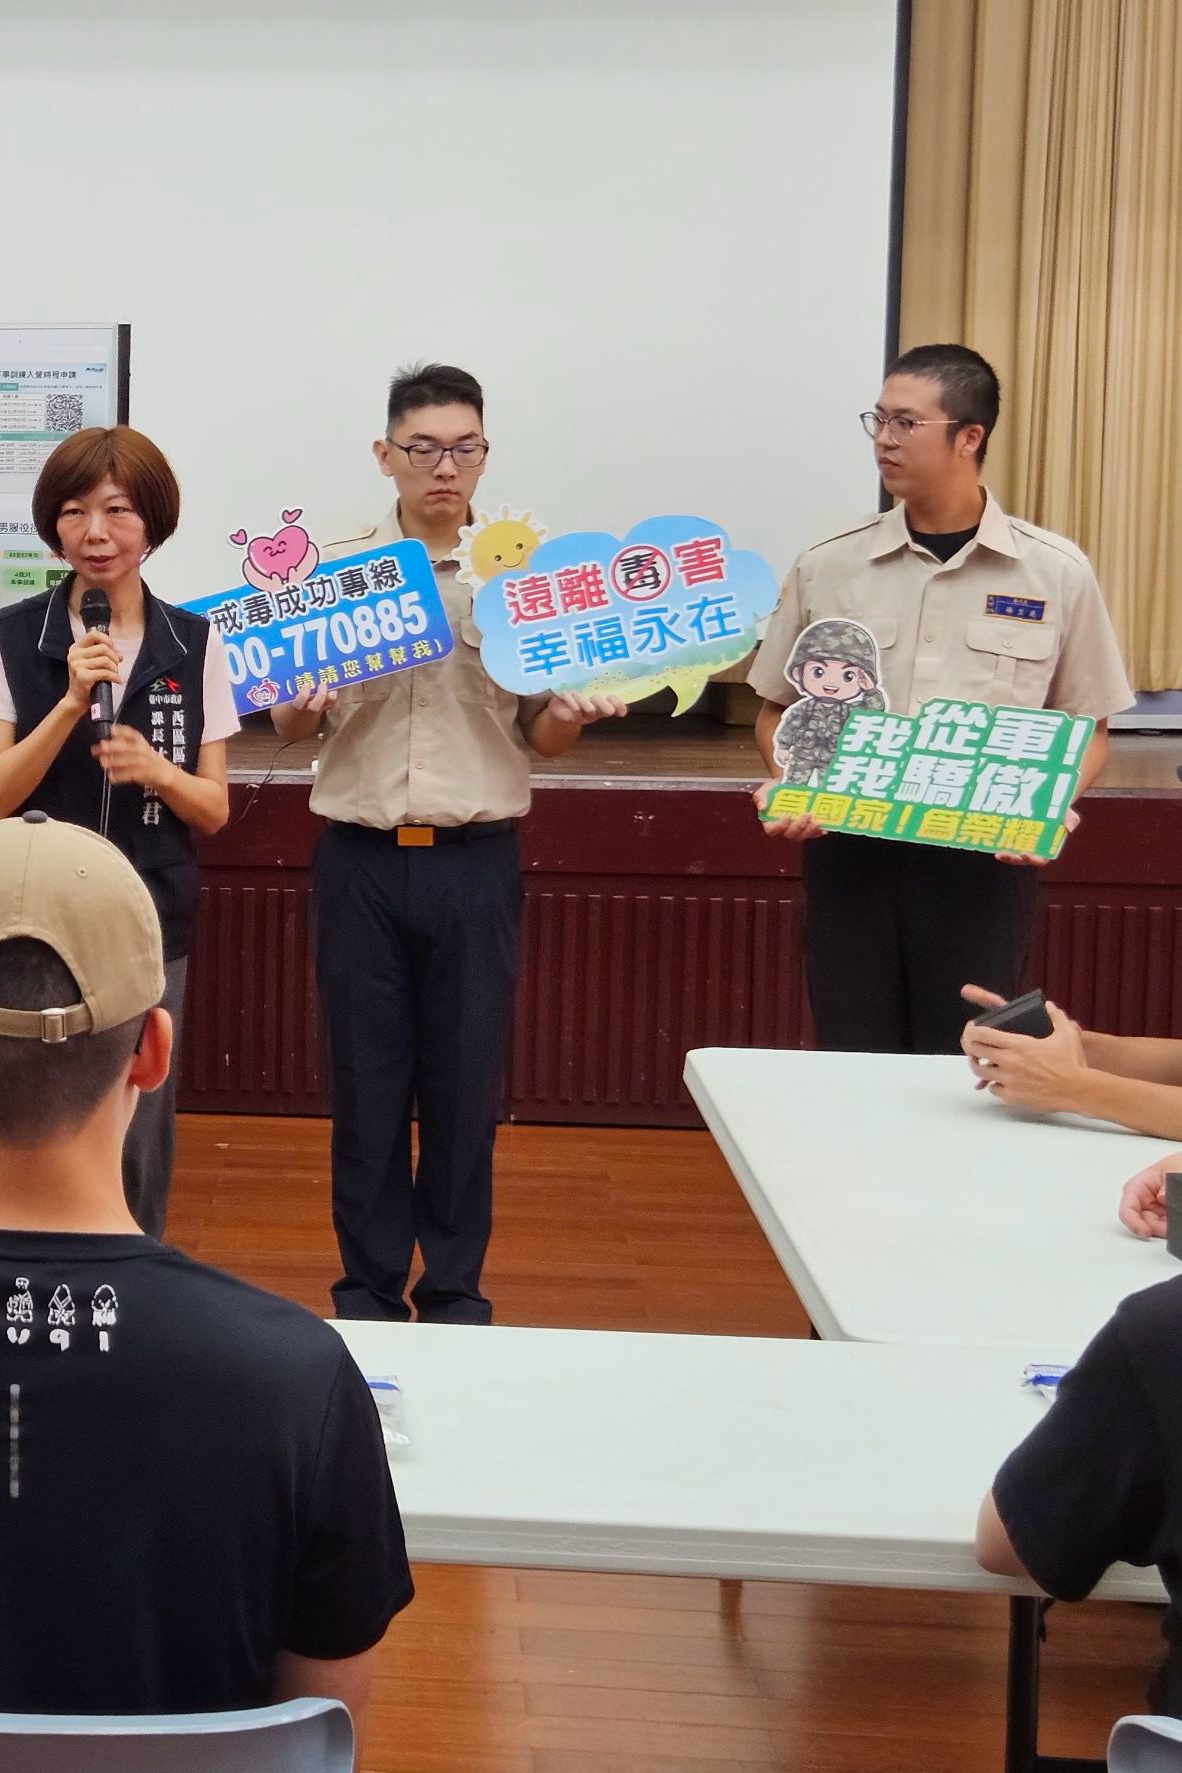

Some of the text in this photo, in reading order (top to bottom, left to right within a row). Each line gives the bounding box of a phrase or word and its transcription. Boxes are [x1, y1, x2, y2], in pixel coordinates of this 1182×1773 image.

[209, 557, 405, 634] 戒毒成功專線
[503, 537, 725, 626] 遠離毒害
[519, 595, 741, 677] 幸福永在
[840, 701, 1089, 766] 我從軍!
[826, 755, 1073, 819] 我驕傲!
